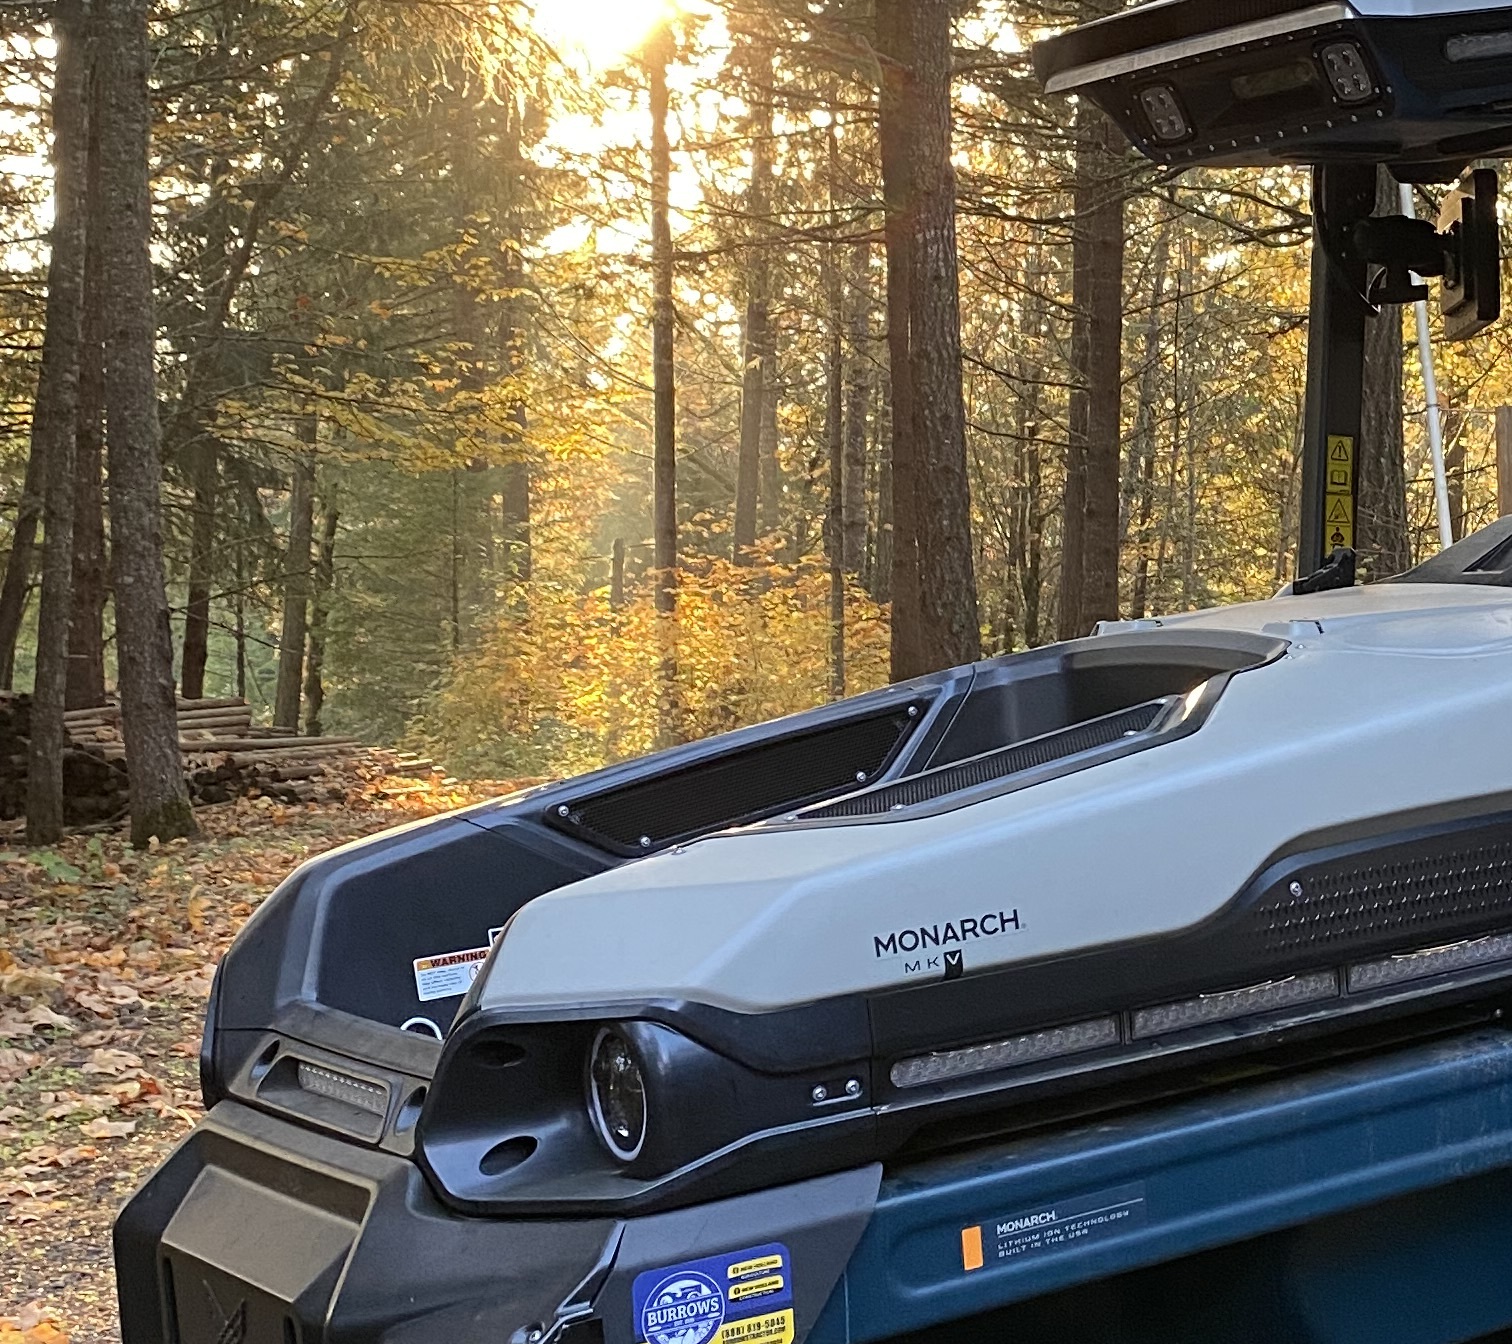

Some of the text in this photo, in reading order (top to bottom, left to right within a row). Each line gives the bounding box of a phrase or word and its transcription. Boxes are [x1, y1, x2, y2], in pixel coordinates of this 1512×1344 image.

[873, 908, 1020, 958] MONARCH
[430, 950, 487, 968] WARNING
[996, 1209, 1056, 1235] MONARCH
[997, 1210, 1130, 1249] LITHIUM ION TECHNOLOGY
[998, 1228, 1089, 1258] BUILT IN THE USA
[647, 1297, 720, 1327] BURROWS
